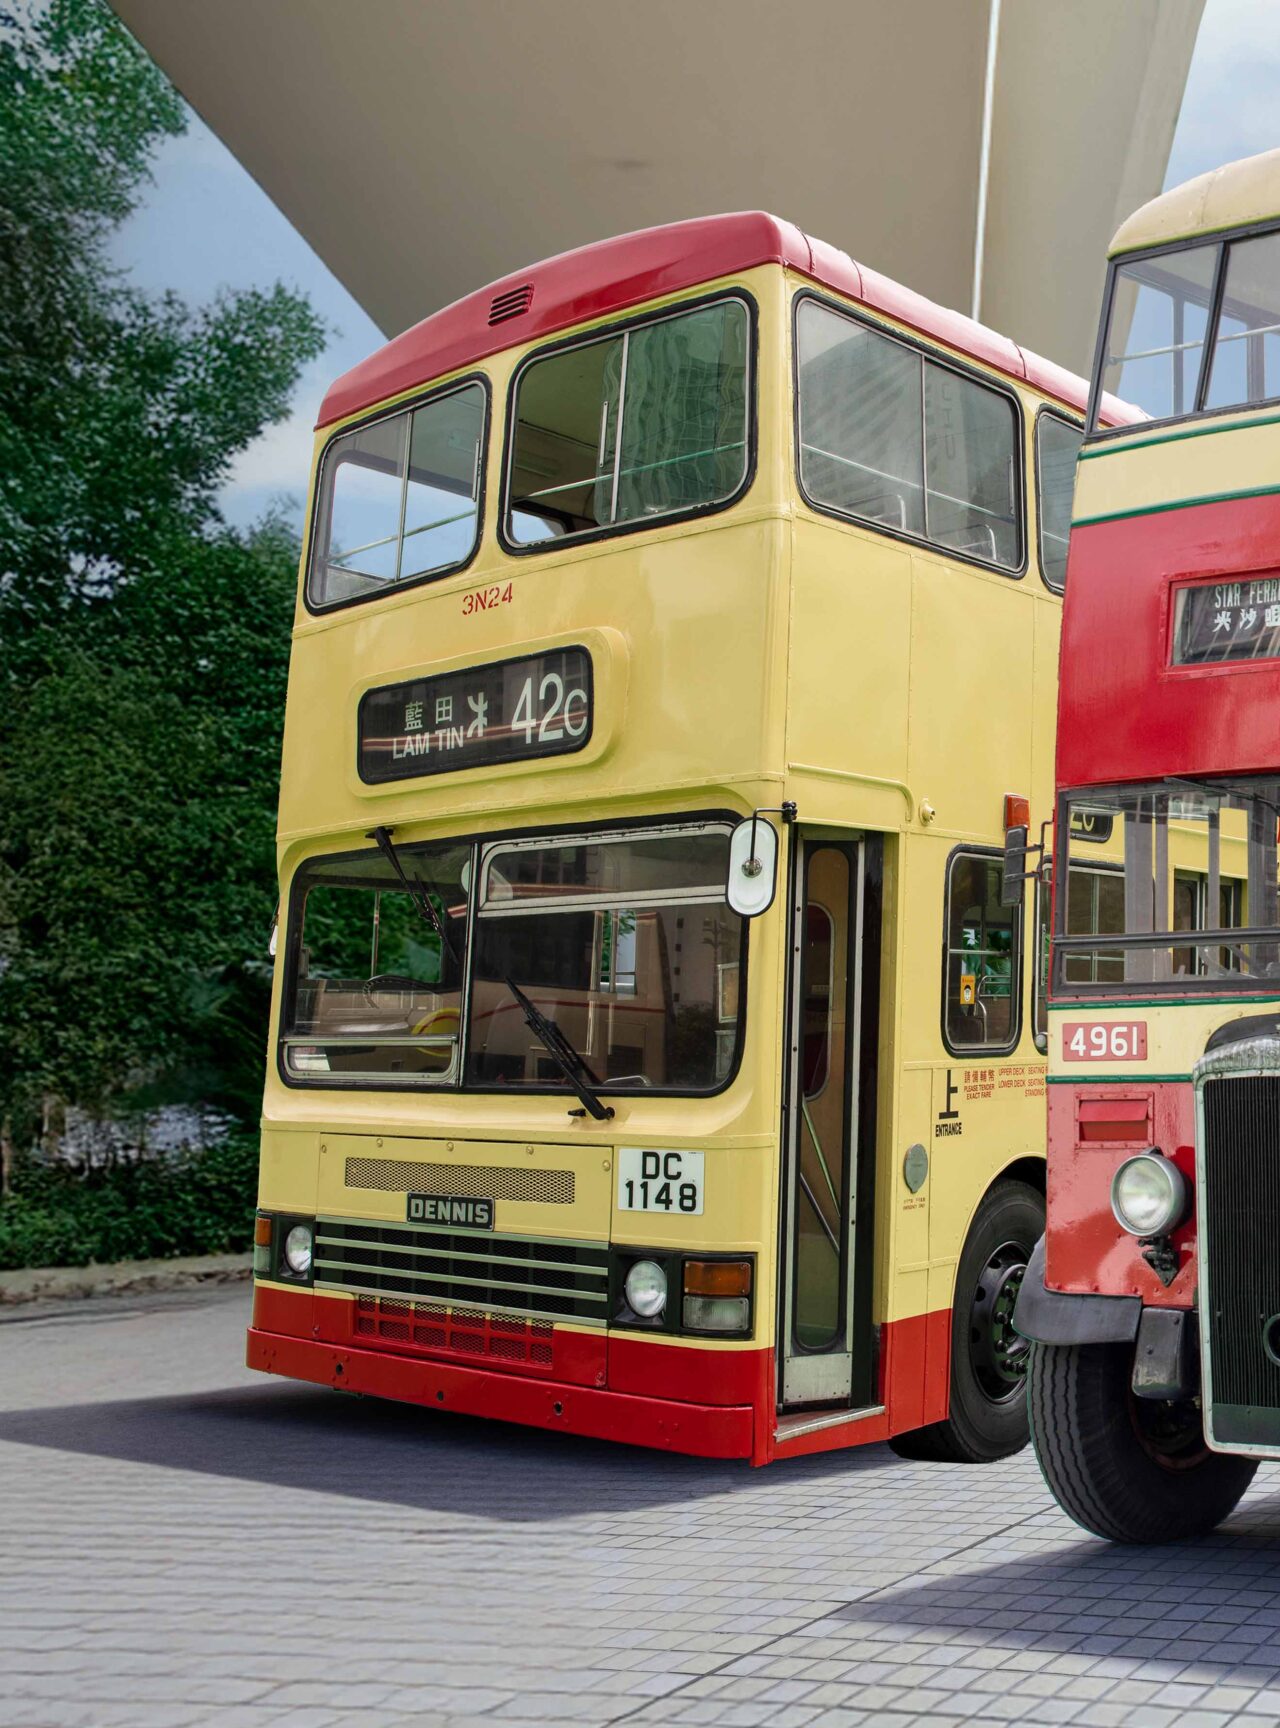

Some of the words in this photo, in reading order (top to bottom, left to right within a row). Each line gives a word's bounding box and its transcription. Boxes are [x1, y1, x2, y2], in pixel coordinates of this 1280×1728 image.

[462, 582, 513, 616] 3N24
[1214, 583, 1241, 609] STAR
[403, 695, 453, 731] 藍田
[392, 731, 430, 760] LAM
[437, 725, 464, 751] TIN
[1070, 1026, 1138, 1057] 4961
[998, 1067, 1012, 1076] UPPER
[1013, 1067, 1025, 1075] DECK
[1028, 1066, 1045, 1075] SEATING
[998, 1079, 1013, 1089] LOWER
[1014, 1079, 1026, 1088] DECK
[1028, 1078, 1044, 1087] SEATING
[964, 1085, 979, 1093] PLEASE
[980, 1083, 995, 1092] TENDER
[966, 1092, 980, 1100] EXACT
[1025, 1089, 1044, 1098] STANDING
[935, 1122, 962, 1138] ENTRANCE
[642, 1151, 682, 1180] DC
[625, 1180, 697, 1212] 1148
[410, 1199, 489, 1224] DENNIS
